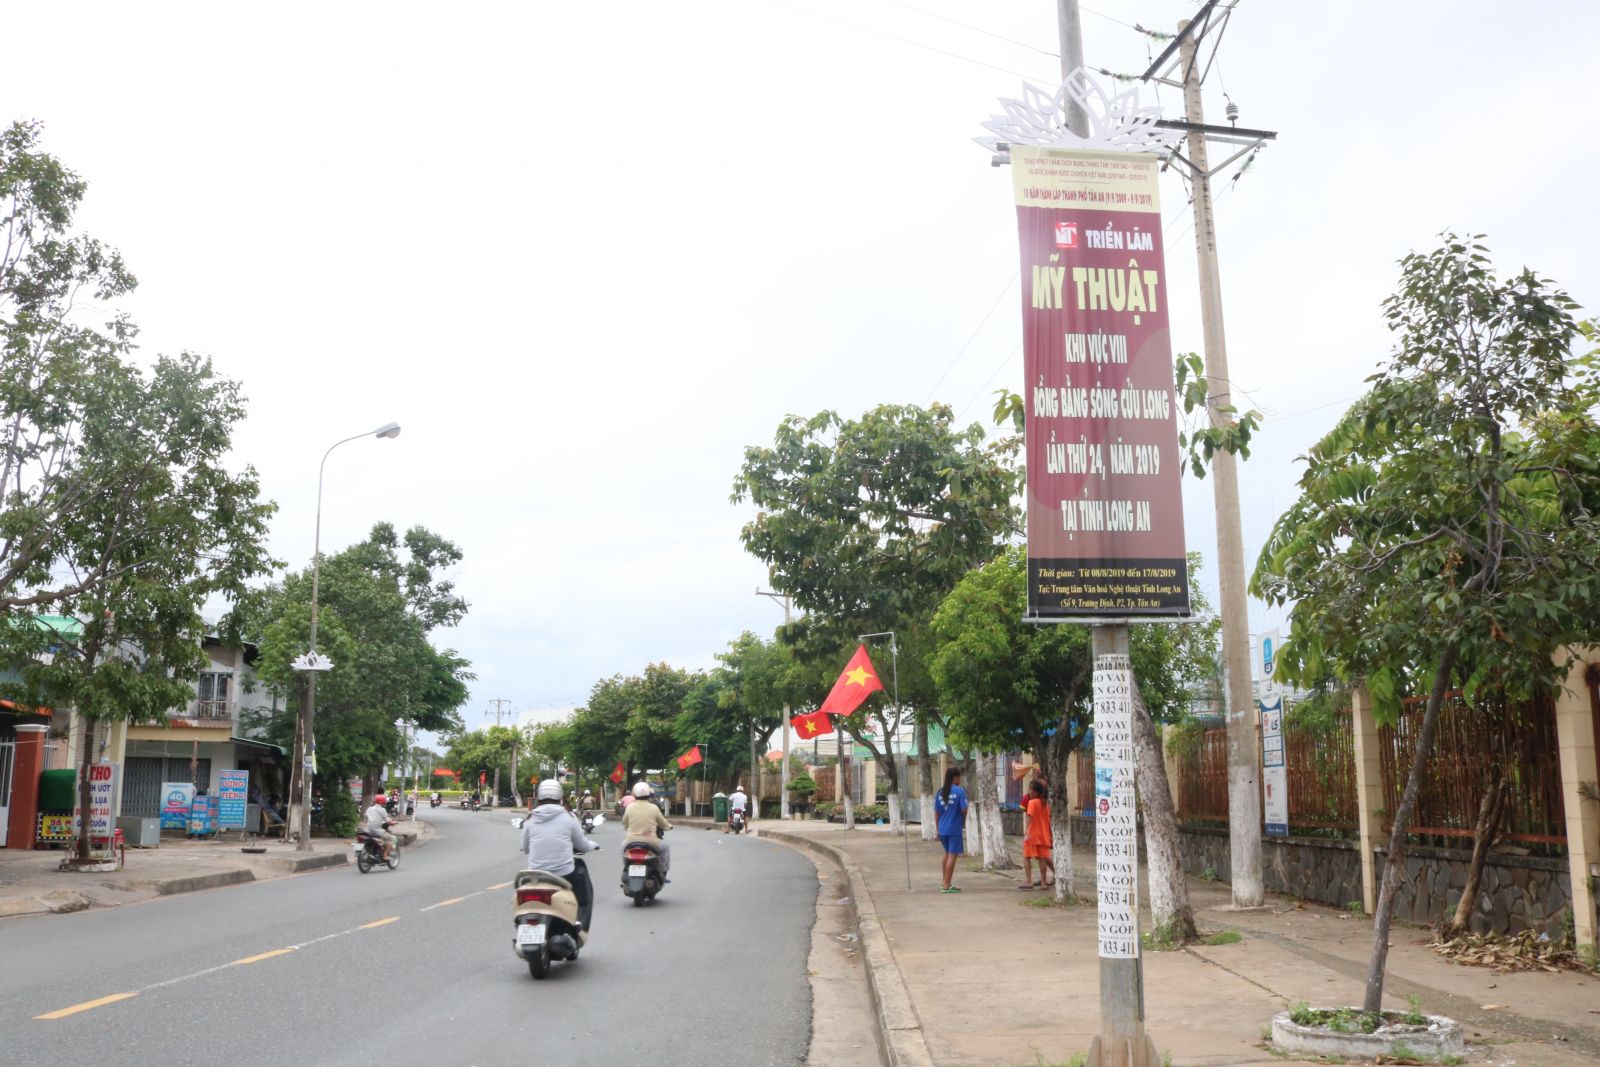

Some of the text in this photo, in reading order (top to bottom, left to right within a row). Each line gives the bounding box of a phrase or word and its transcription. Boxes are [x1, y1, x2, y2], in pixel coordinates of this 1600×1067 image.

[1085, 221, 1153, 251] TRIỂN LÃM
[1032, 253, 1158, 326] MỸ THUẬT
[1065, 328, 1128, 372] KHU VỰC VIII
[1034, 374, 1170, 420] ĐỒNG BẰNG SÔNG CỬU LONG
[1046, 431, 1160, 480] LẦN THỨ 24, NĂM 2019
[1061, 487, 1151, 541] TẠI TỈNH LONG AN
[1038, 567, 1176, 580] Thời gian: Từ 08/8/2019 đến 17/8/2019
[1052, 584, 1070, 595] Trung
[1156, 585, 1172, 595] Long
[1172, 585, 1181, 593] An
[1149, 599, 1161, 609] An)
[1107, 673, 1126, 682] VAY
[1100, 701, 1130, 714] 833 411
[1107, 720, 1128, 729] VAY
[1106, 730, 1130, 741] GÓP
[1118, 749, 1130, 761] 411
[170, 793, 184, 801] 4G
[1122, 796, 1134, 808] 411
[1111, 815, 1130, 824] VAY
[1111, 825, 1134, 836] GÓP
[1104, 843, 1120, 856] 833
[1122, 844, 1135, 856] 411
[1112, 863, 1132, 872] VAY
[1111, 874, 1135, 886] GÓP
[1104, 891, 1120, 904] 833
[1122, 893, 1135, 905] 411
[1110, 912, 1130, 921] VAY
[1110, 922, 1134, 934] GÓP
[1104, 941, 1135, 955] 833 411
